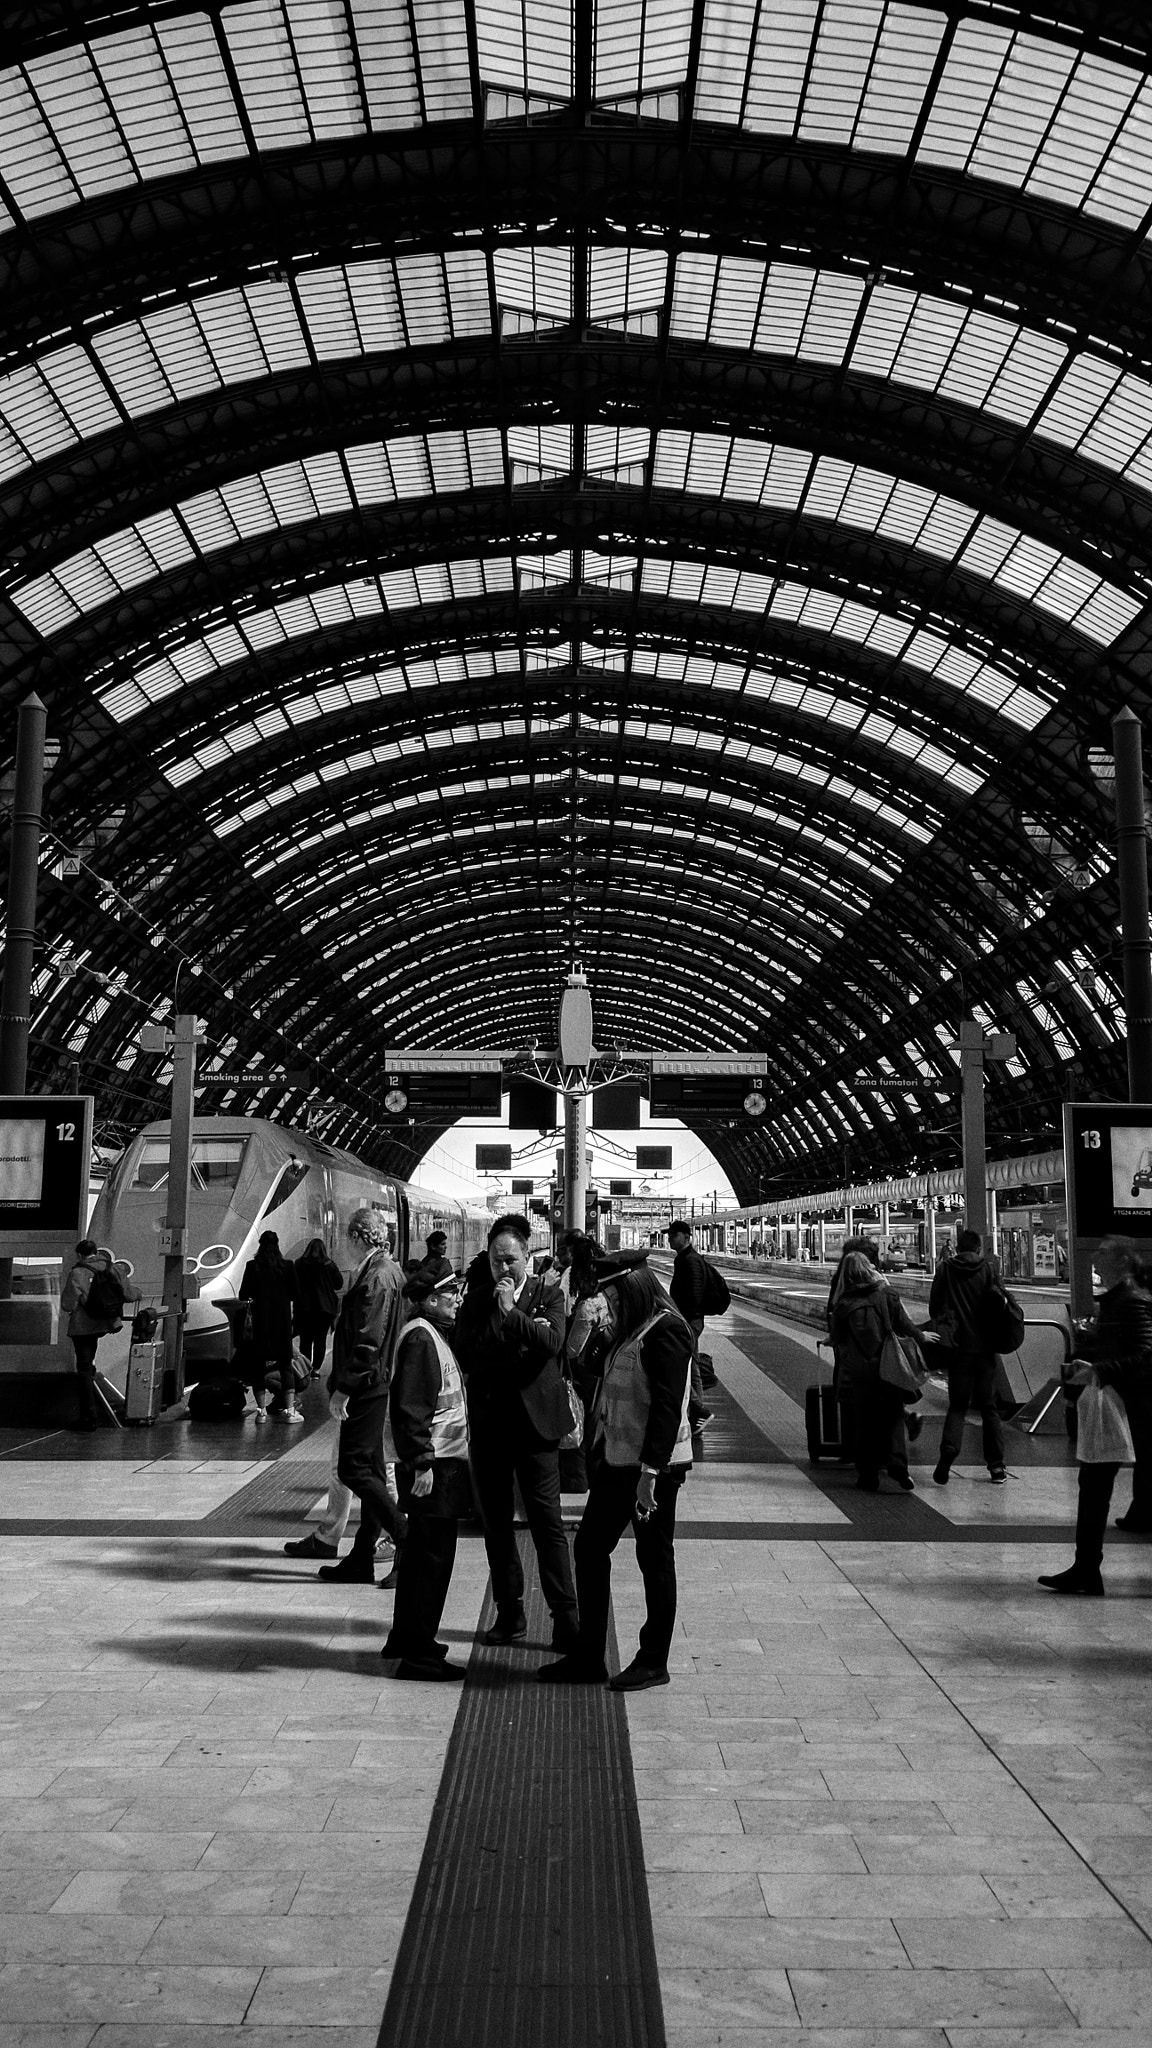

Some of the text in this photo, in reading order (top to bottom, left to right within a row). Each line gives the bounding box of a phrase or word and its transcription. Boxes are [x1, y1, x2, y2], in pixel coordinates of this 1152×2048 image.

[199, 1073, 239, 1083] Smoking
[388, 1076, 399, 1086] 12
[853, 1078, 918, 1086] Zona fumatori
[752, 1079, 763, 1088] 13
[56, 1123, 75, 1141] 12
[1081, 1130, 1101, 1148] 13
[161, 1236, 171, 1245] 12
